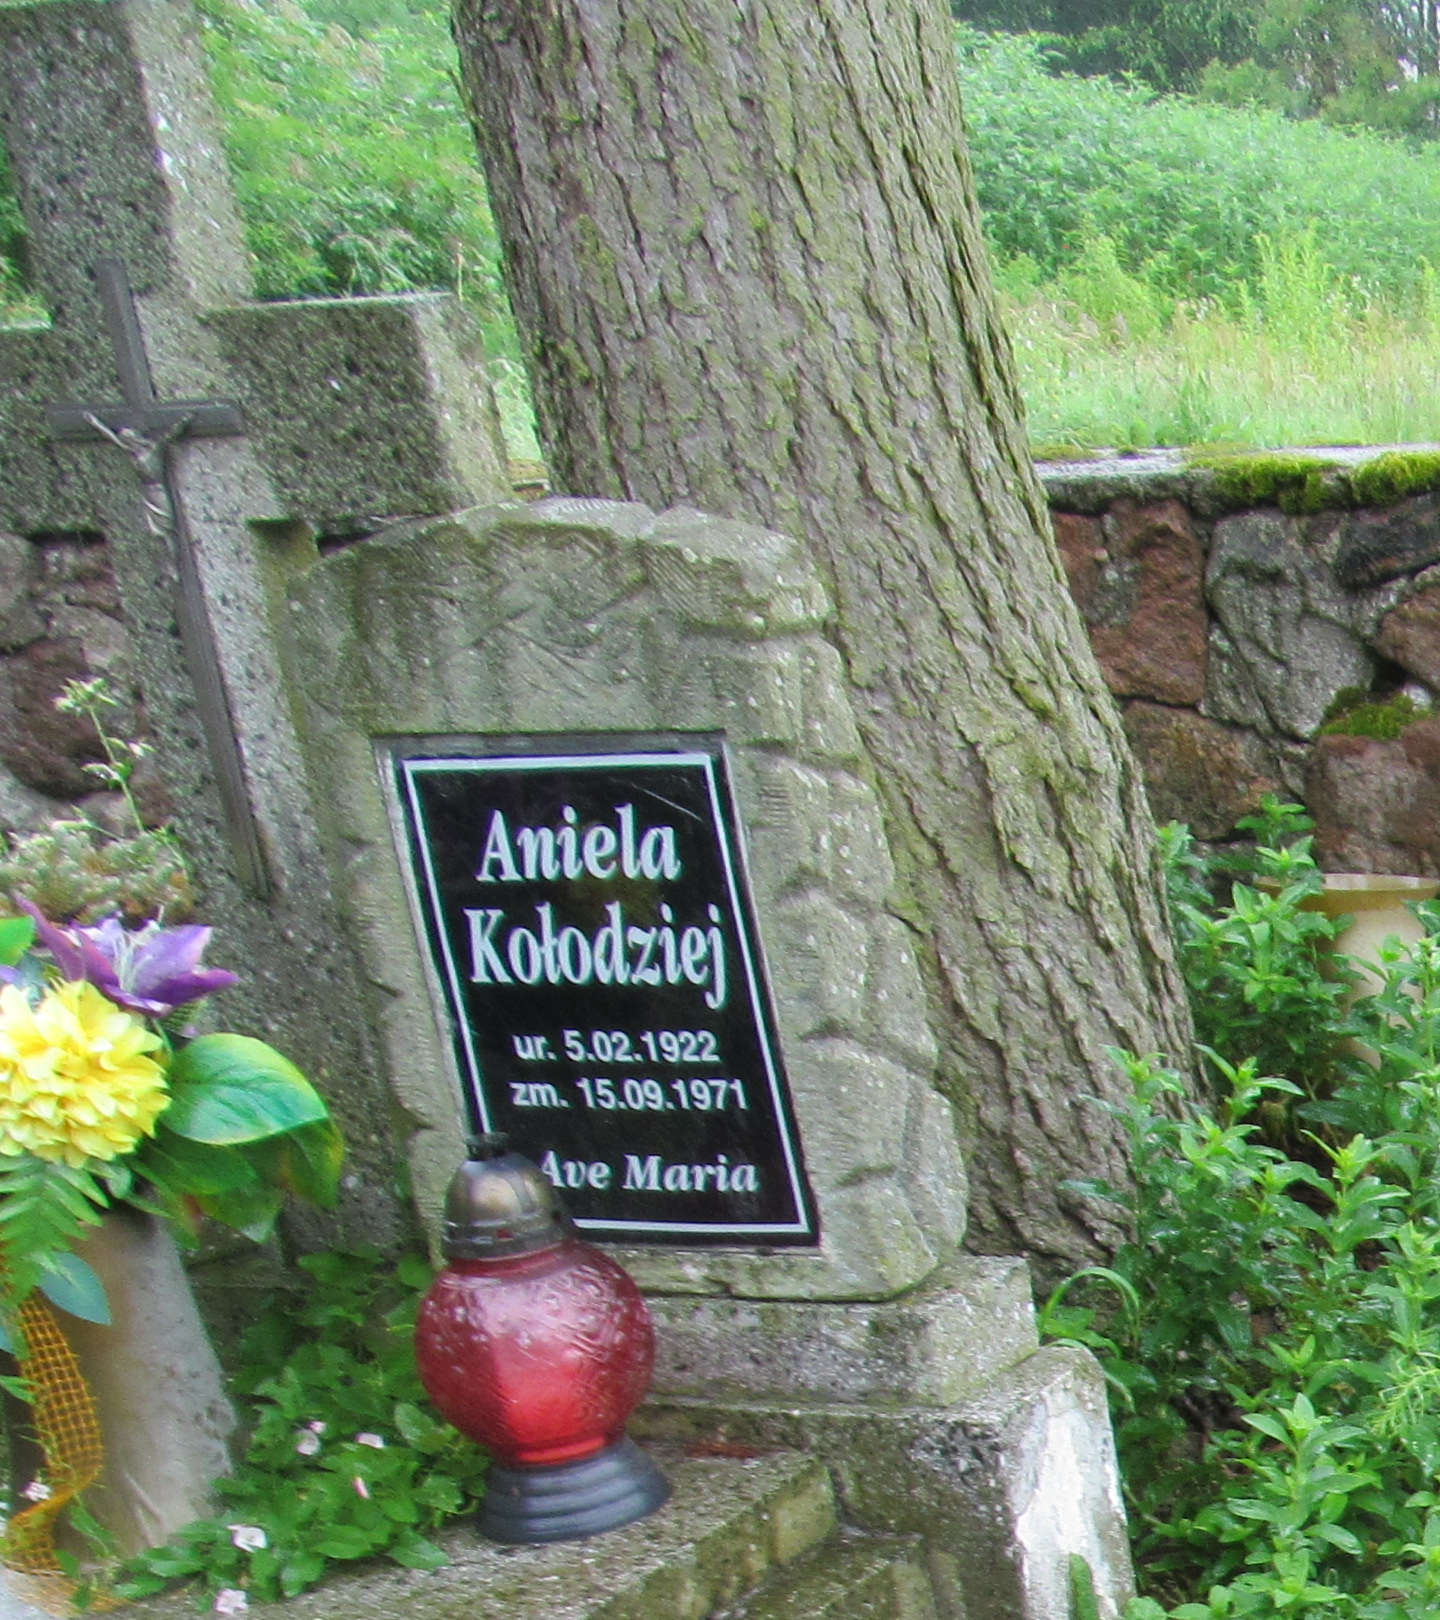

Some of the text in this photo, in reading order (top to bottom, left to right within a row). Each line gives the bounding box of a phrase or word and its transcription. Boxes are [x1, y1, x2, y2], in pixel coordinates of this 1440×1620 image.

[475, 803, 681, 881] Aniela
[463, 902, 729, 1010] Kołodziej
[514, 1030, 720, 1063] ur. 5.02.1922
[509, 1079, 748, 1111] zm. 15.09.1971
[540, 1150, 759, 1193] Ave Maria
